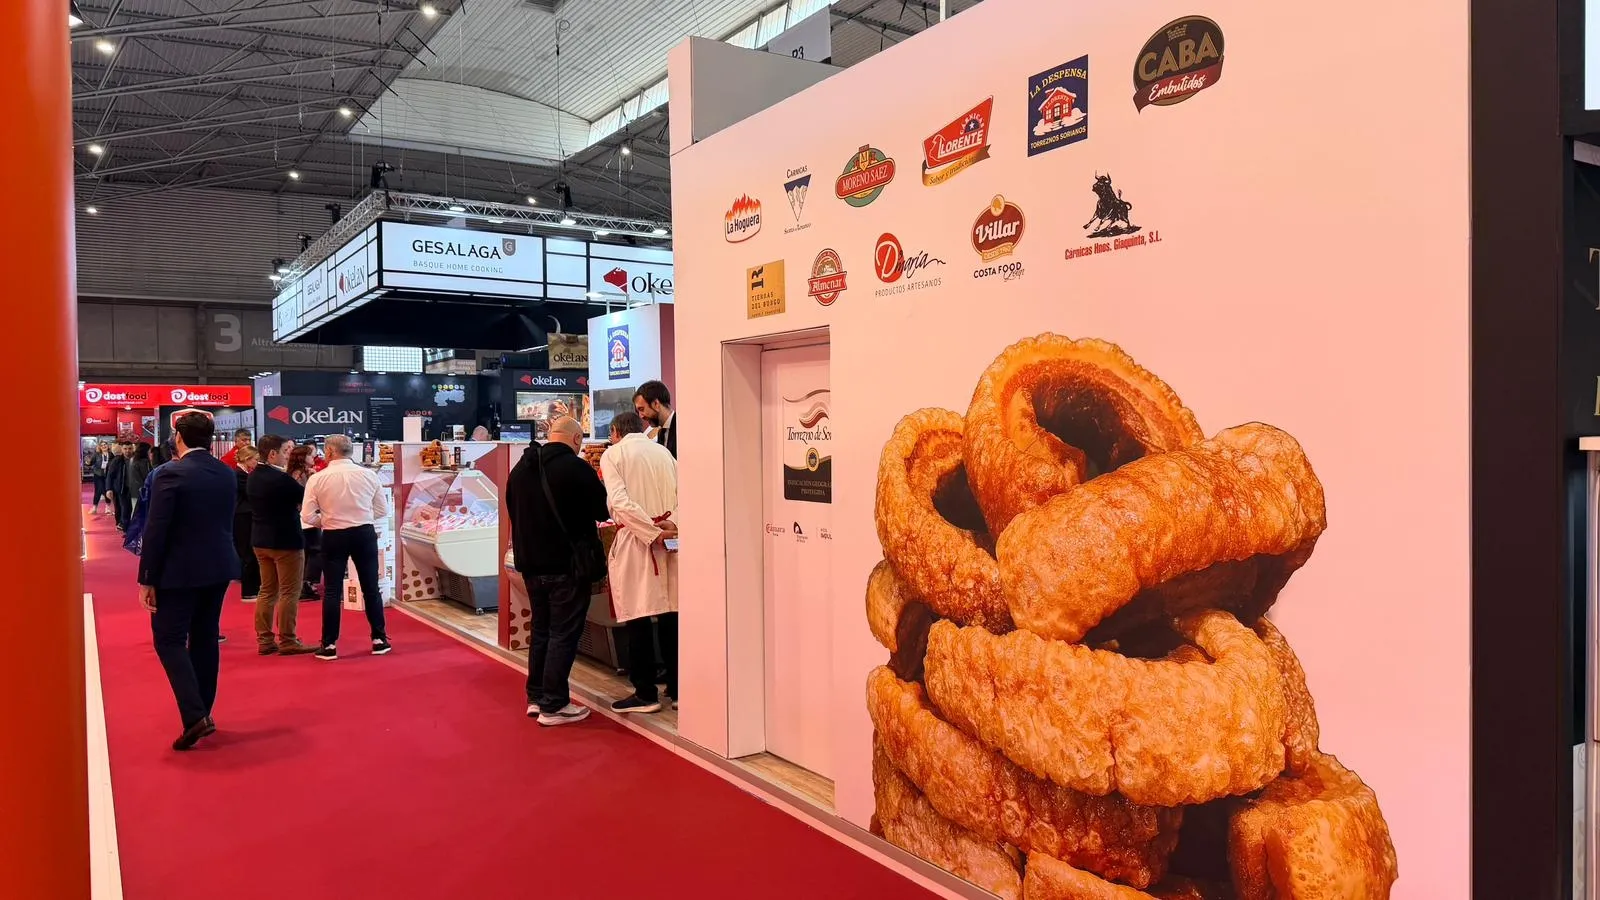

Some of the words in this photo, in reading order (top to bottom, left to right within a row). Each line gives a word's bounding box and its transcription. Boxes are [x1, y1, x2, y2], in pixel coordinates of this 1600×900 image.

[1139, 32, 1218, 81] CABA
[1030, 85, 1041, 98] LA
[1042, 68, 1087, 88] DESPENSA
[1148, 74, 1207, 101] Embutidos
[1031, 134, 1060, 149] TORREZNOS
[1060, 126, 1086, 140] SORIANOS
[842, 171, 869, 192] MORENO
[726, 221, 734, 235] La
[734, 213, 760, 233] Hoguera
[975, 219, 1020, 244] Villar
[412, 239, 501, 260] GESALAGA
[413, 260, 444, 269] BASQUE
[446, 263, 469, 271] HOME
[470, 265, 503, 274] COOKING
[973, 267, 996, 279] COSTA
[998, 261, 1022, 275] FOOD
[811, 278, 843, 292] Almenar
[875, 285, 906, 298] PRODUCTOS
[907, 277, 942, 291] ARTESANOS
[751, 291, 774, 302] TIERRAS
[214, 313, 242, 352] 3
[104, 391, 147, 401] dostfood
[187, 391, 229, 401] dostfood
[786, 426, 813, 445] Torrezno
[814, 424, 822, 441] de
